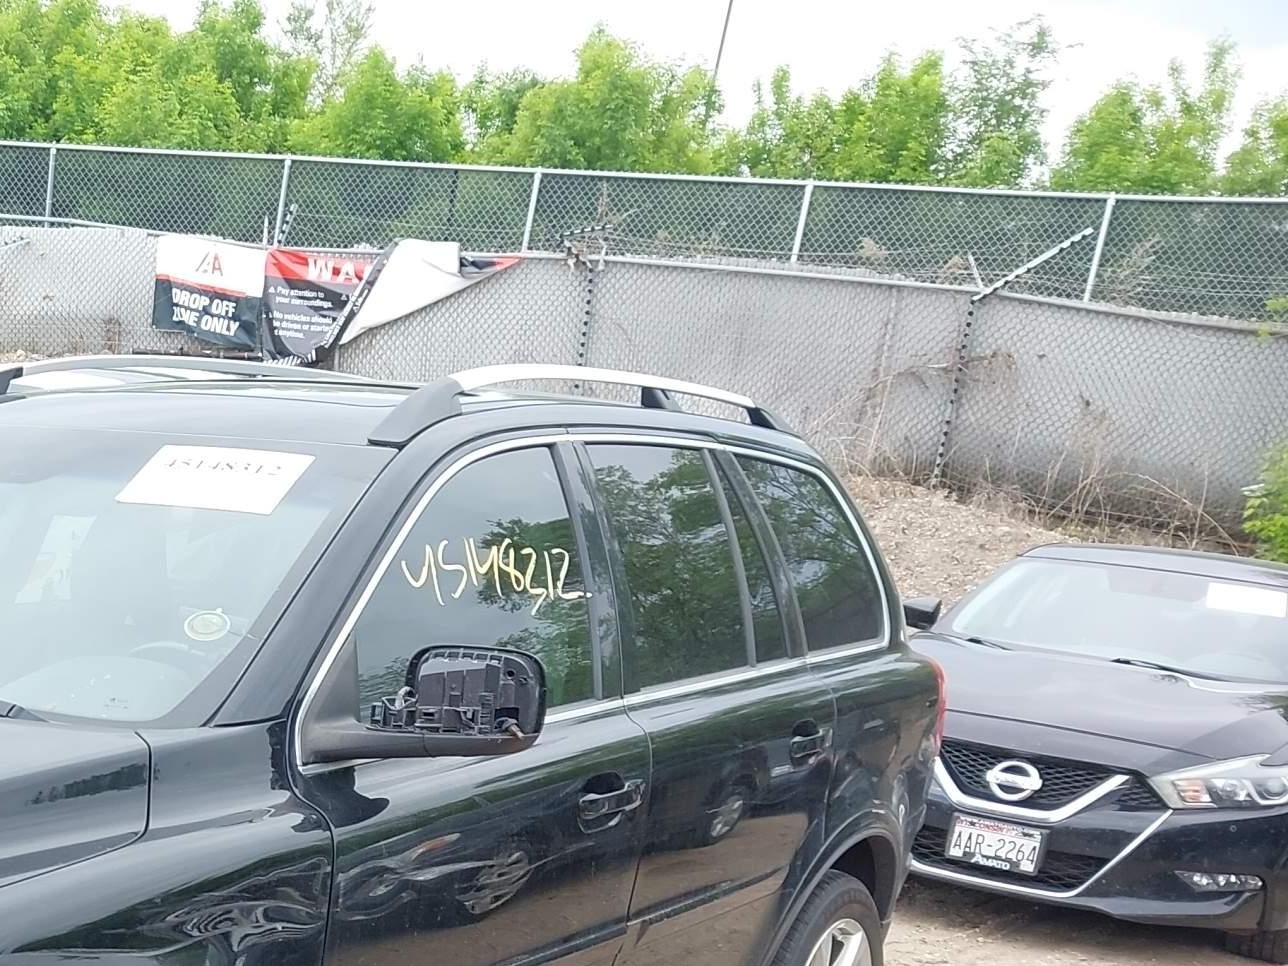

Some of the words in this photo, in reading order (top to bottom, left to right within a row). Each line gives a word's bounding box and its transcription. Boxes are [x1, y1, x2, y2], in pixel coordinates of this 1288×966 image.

[171, 288, 210, 311] DROP
[211, 299, 237, 318] OFF
[200, 315, 240, 337] ONLY
[952, 830, 1037, 865] AAR-2264
